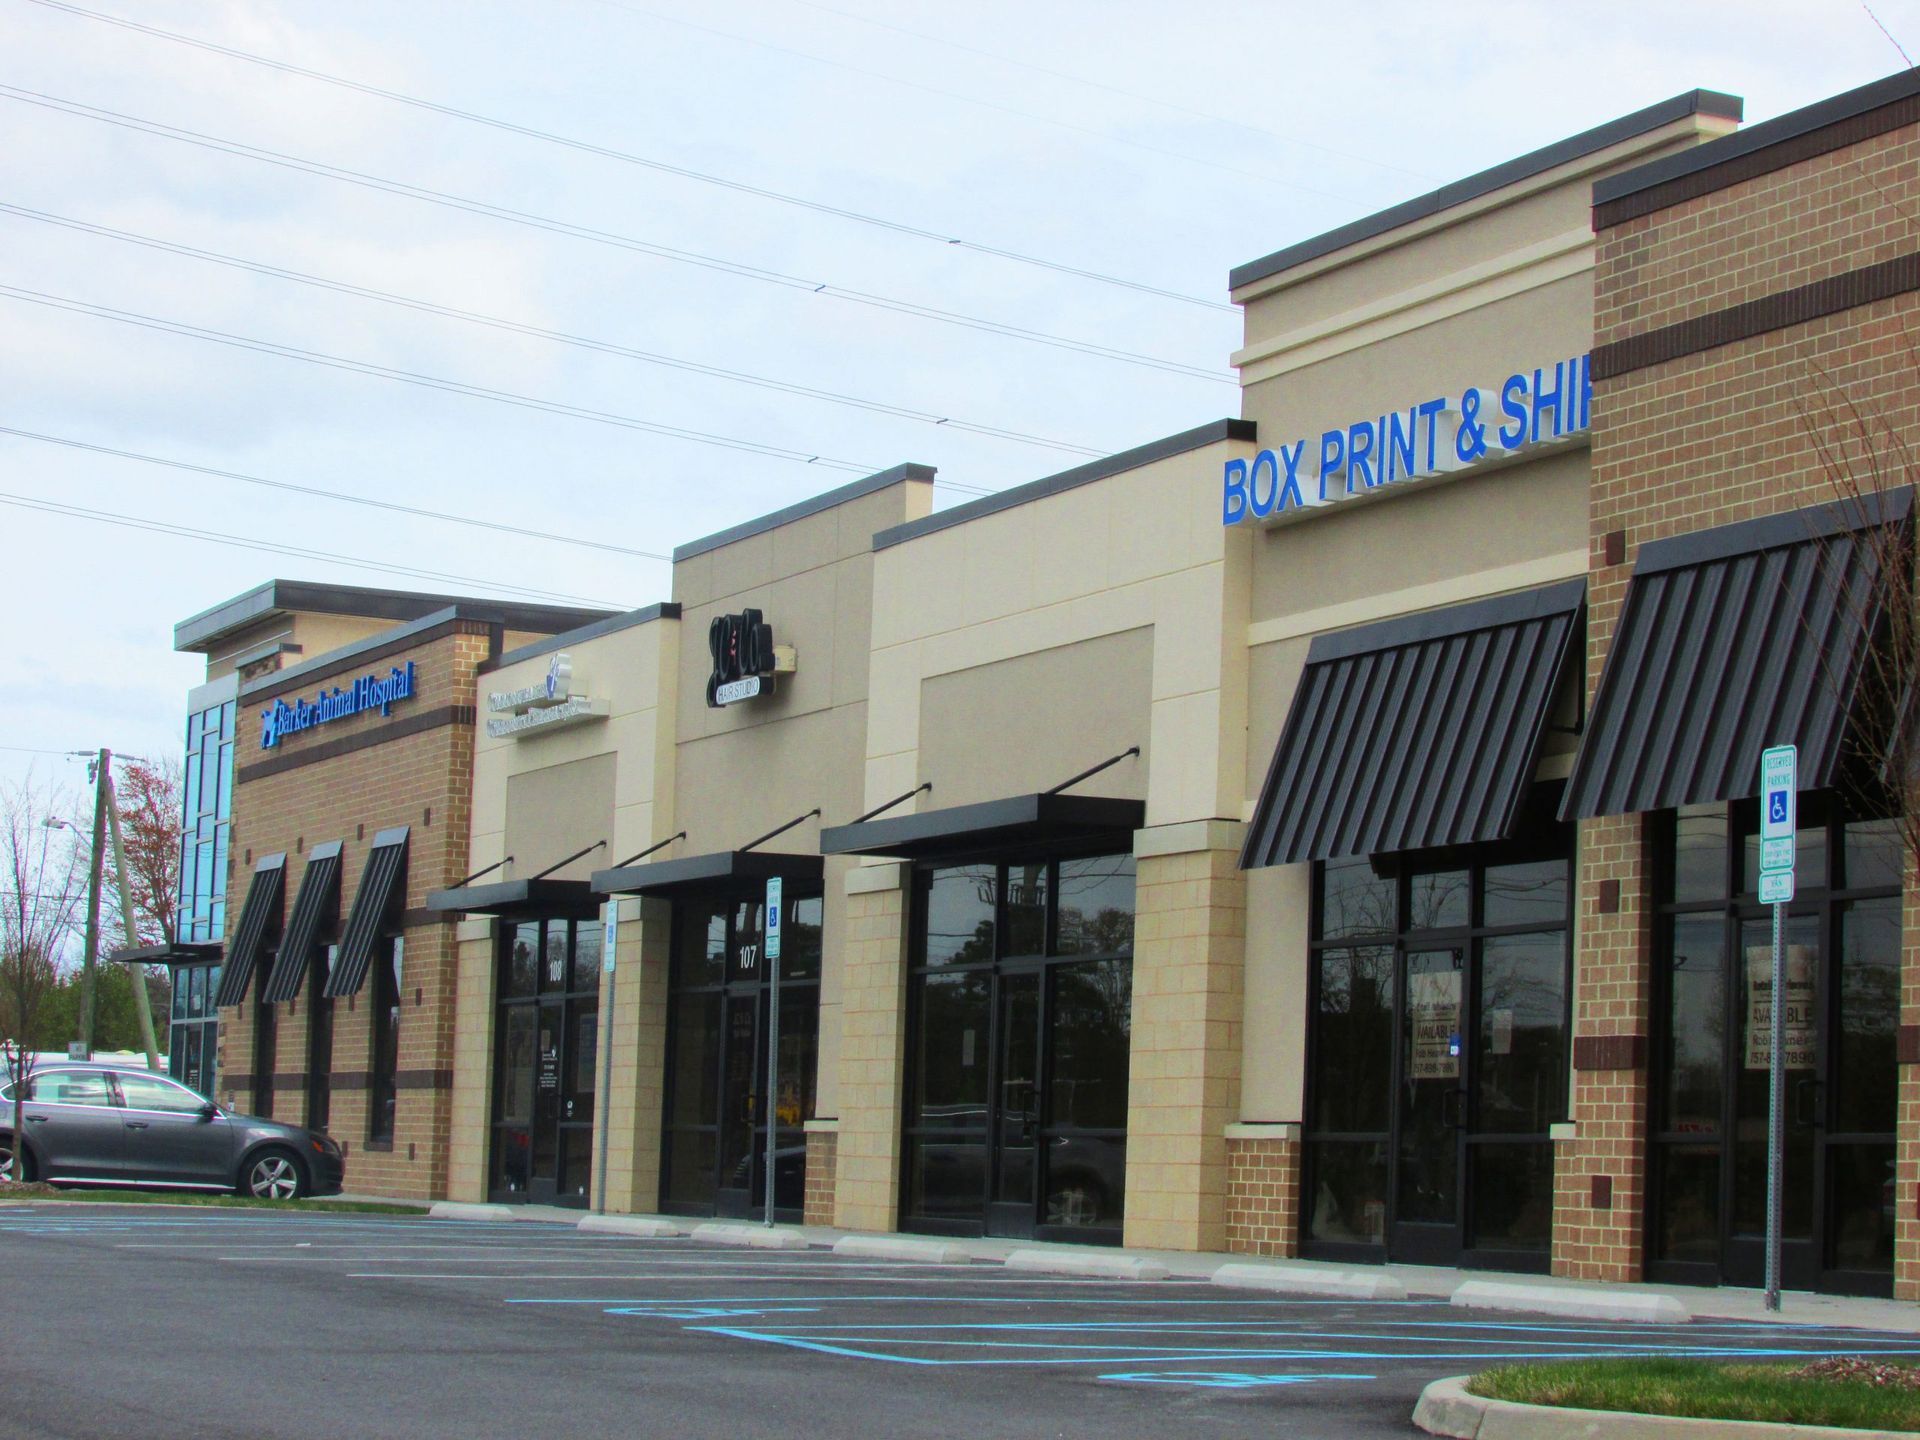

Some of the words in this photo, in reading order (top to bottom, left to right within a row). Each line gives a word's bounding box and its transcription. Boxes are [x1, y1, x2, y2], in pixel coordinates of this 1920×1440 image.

[1222, 440, 1305, 527] BOX
[1318, 397, 1447, 500] PRINT
[1455, 387, 1489, 463] &
[277, 700, 313, 736] Barker
[314, 687, 356, 725] Animal
[358, 662, 413, 717] Hospital
[717, 685, 734, 702] HAIR
[734, 678, 760, 698] STUDIO
[740, 945, 757, 968] 107
[549, 960, 562, 982] 108
[1753, 1007, 1814, 1024] AVABLE
